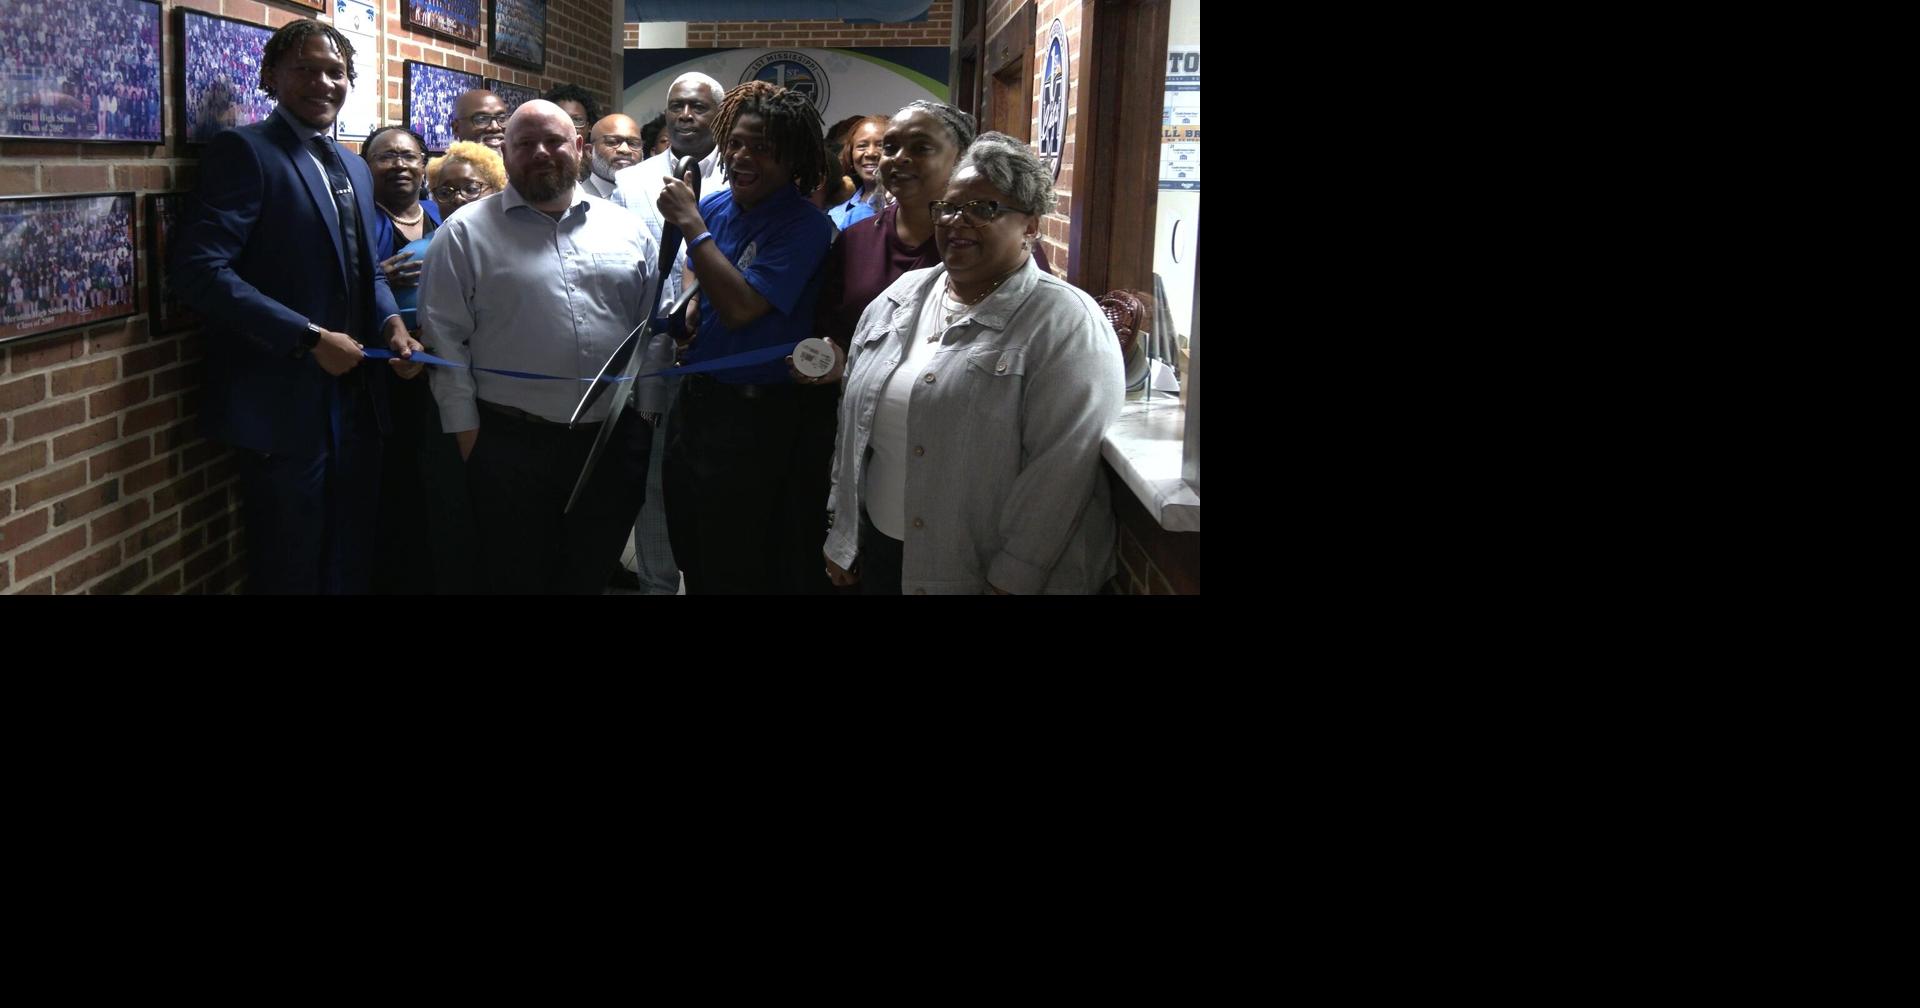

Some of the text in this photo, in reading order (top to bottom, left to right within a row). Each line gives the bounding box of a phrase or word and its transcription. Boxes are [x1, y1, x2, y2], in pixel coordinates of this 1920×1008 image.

[752, 53, 818, 72] 1ST MISSISSIPPI
[57, 112, 76, 123] School
[23, 122, 40, 132] Class
